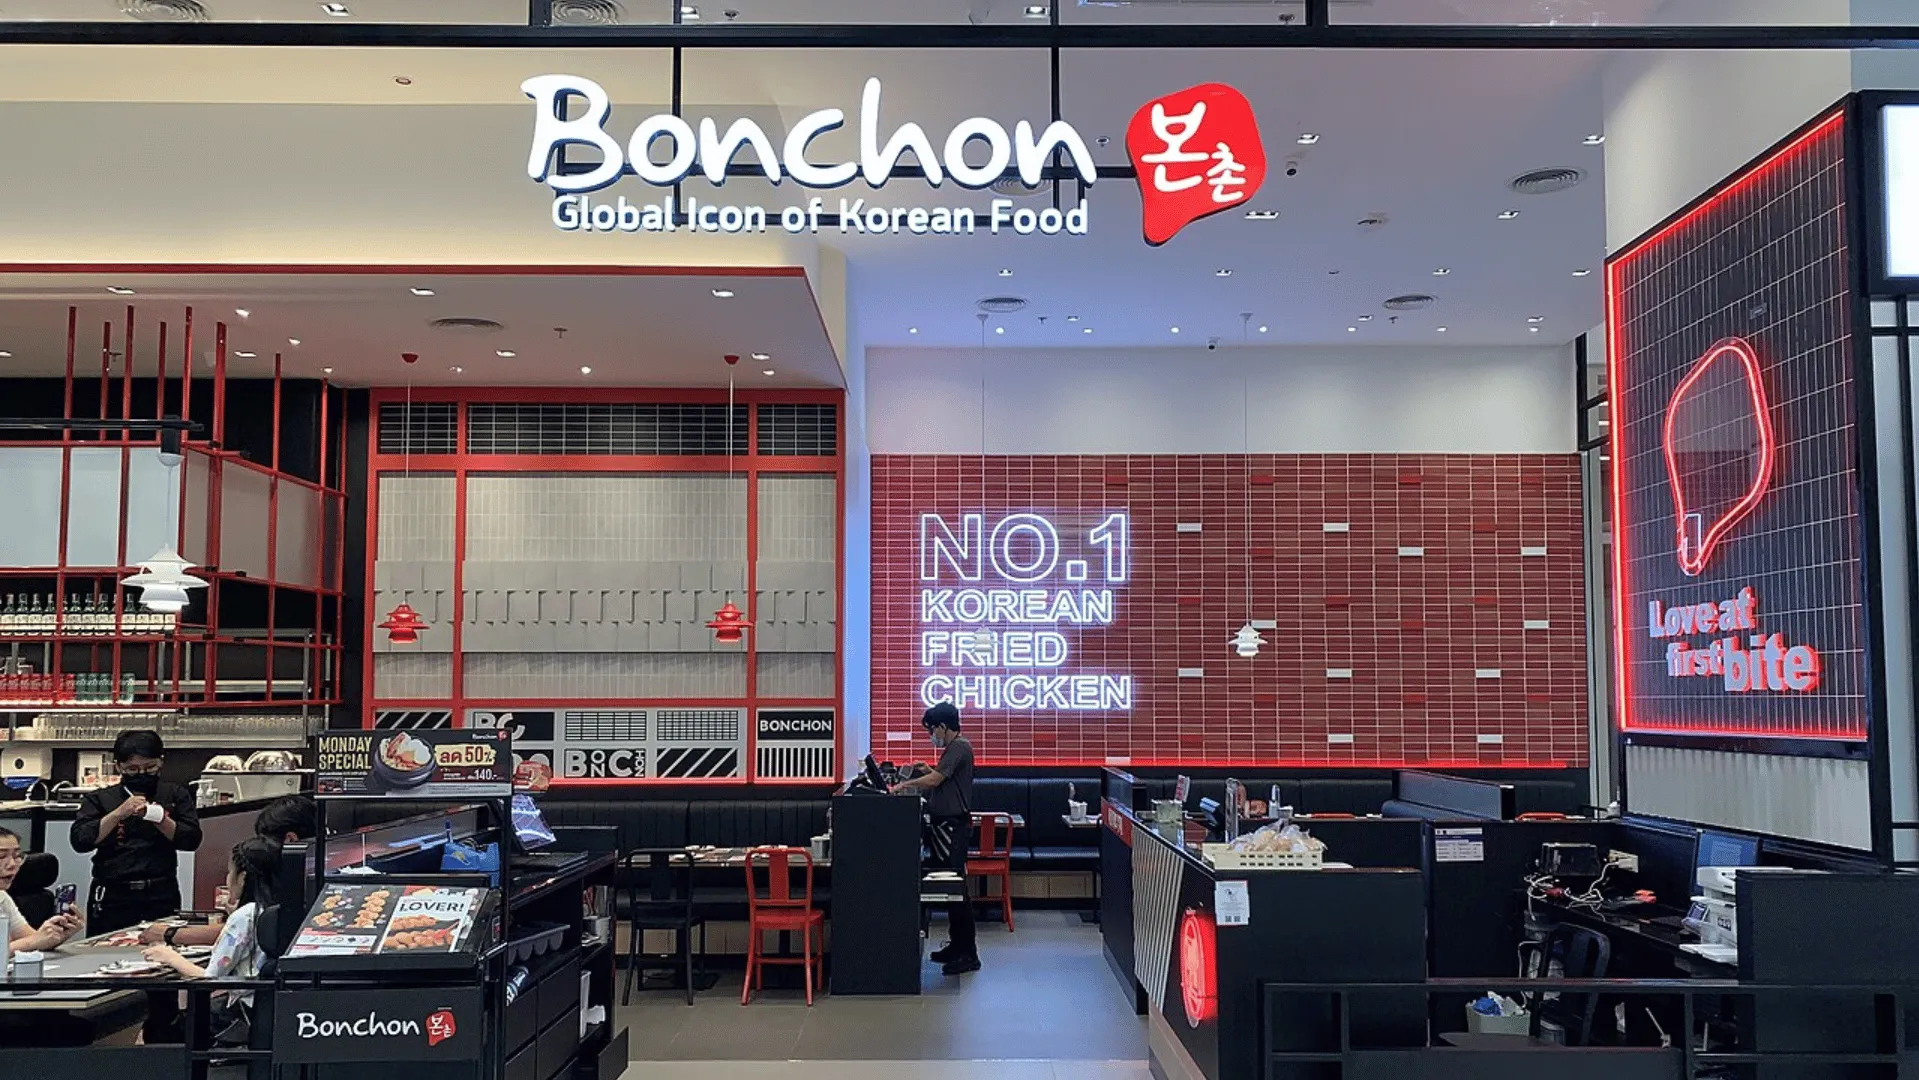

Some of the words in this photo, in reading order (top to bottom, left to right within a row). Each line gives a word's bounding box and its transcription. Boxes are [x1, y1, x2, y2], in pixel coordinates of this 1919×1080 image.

[521, 74, 1098, 188] Bonchon
[1141, 101, 1246, 203] 본촌
[552, 195, 675, 234] Global
[688, 197, 766, 234] Icon
[782, 197, 823, 234] of
[840, 200, 973, 234] Korean
[991, 200, 1088, 234] Food
[920, 513, 1128, 582] NO.1
[921, 588, 1113, 623] KOREAN
[1648, 600, 1718, 638] Love
[1718, 586, 1757, 632] at
[921, 631, 1068, 667] FRIED
[1666, 640, 1724, 677] first
[1723, 632, 1821, 692] bite
[920, 674, 1132, 710] CHICKEN
[760, 719, 832, 732] BONCHON
[318, 736, 373, 753] MONDAY
[318, 754, 372, 770] SPECIAL
[440, 750, 463, 764] ลด
[465, 745, 493, 764] 50%
[399, 901, 465, 913] LOVER!
[296, 1011, 420, 1039] Bonchon
